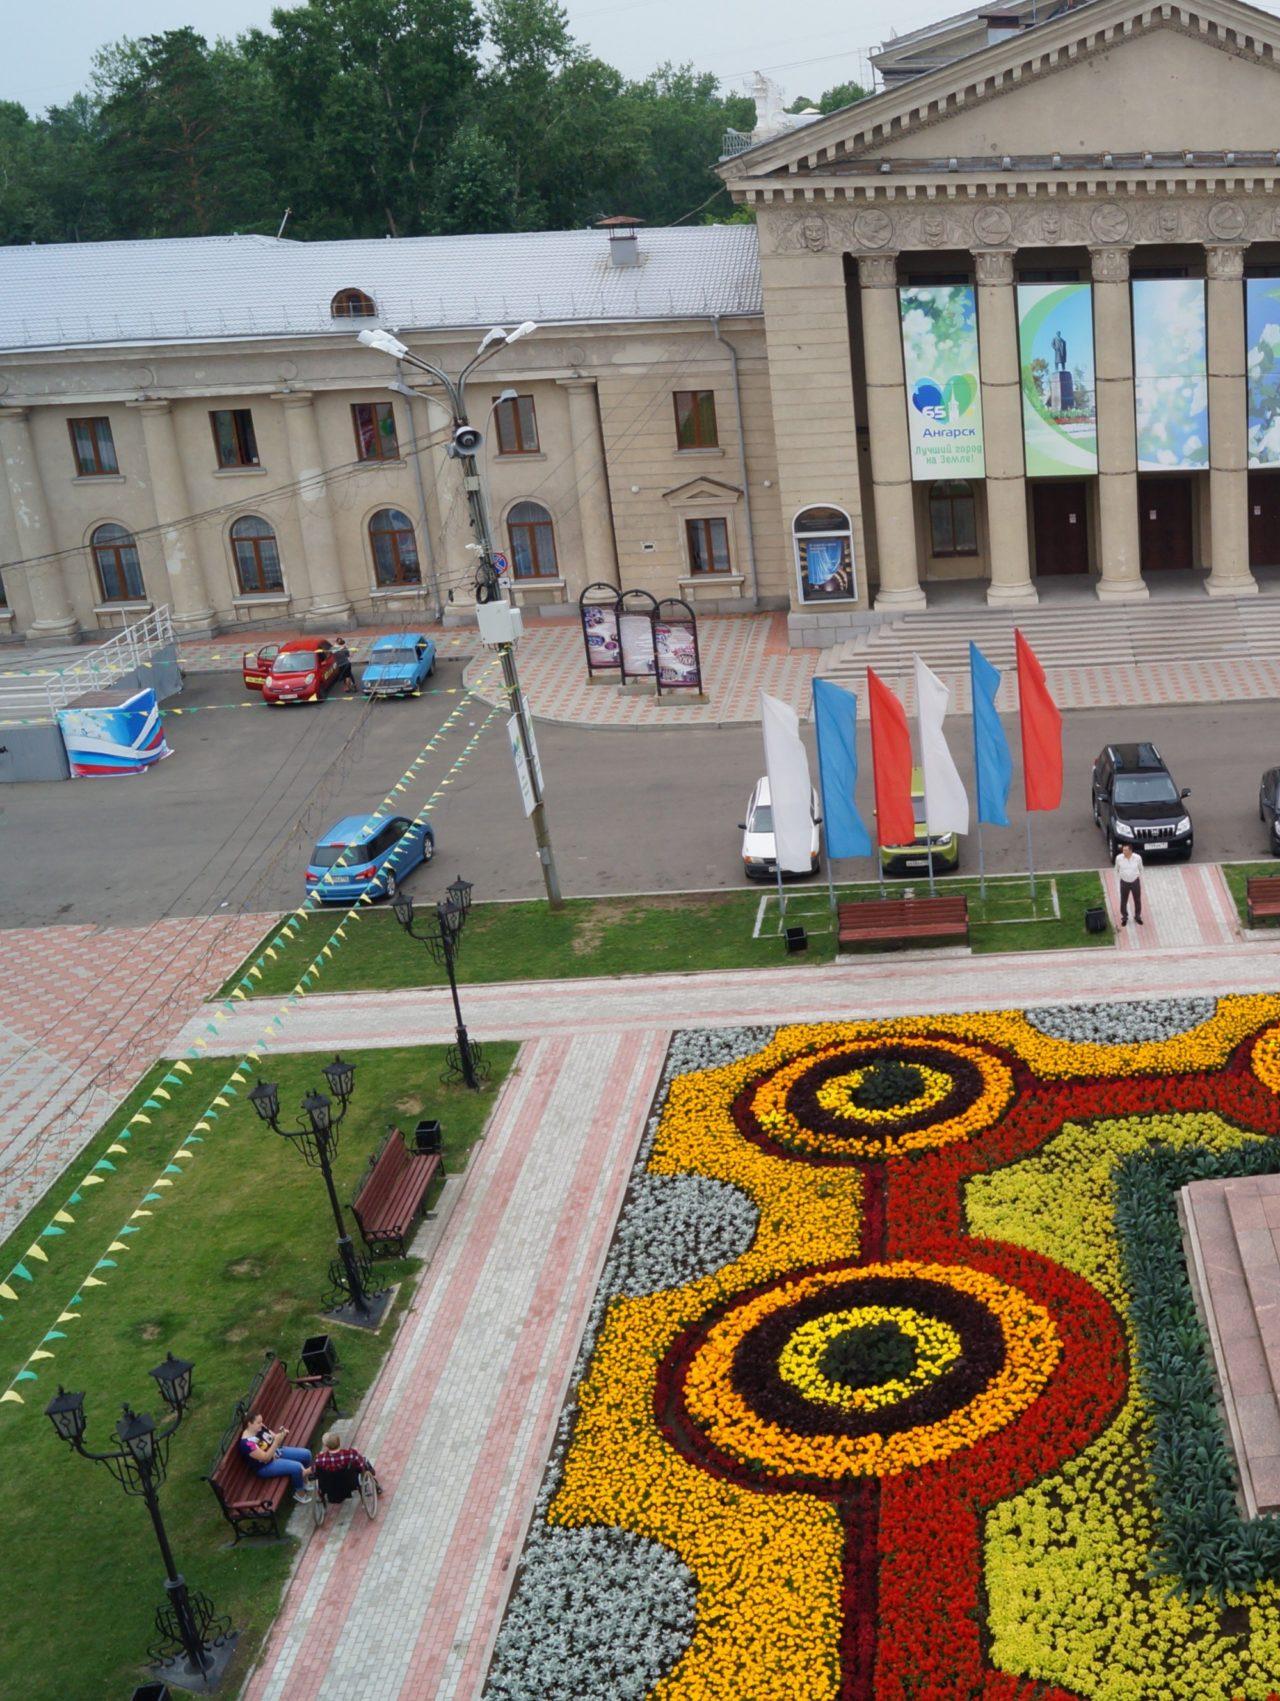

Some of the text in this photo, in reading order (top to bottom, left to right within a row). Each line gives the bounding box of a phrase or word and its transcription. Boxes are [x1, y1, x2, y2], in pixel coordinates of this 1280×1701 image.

[922, 406, 947, 419] 65
[923, 428, 976, 439] Ангарск
[916, 443, 982, 456] Лучший город
[926, 454, 974, 464] на Земле!
